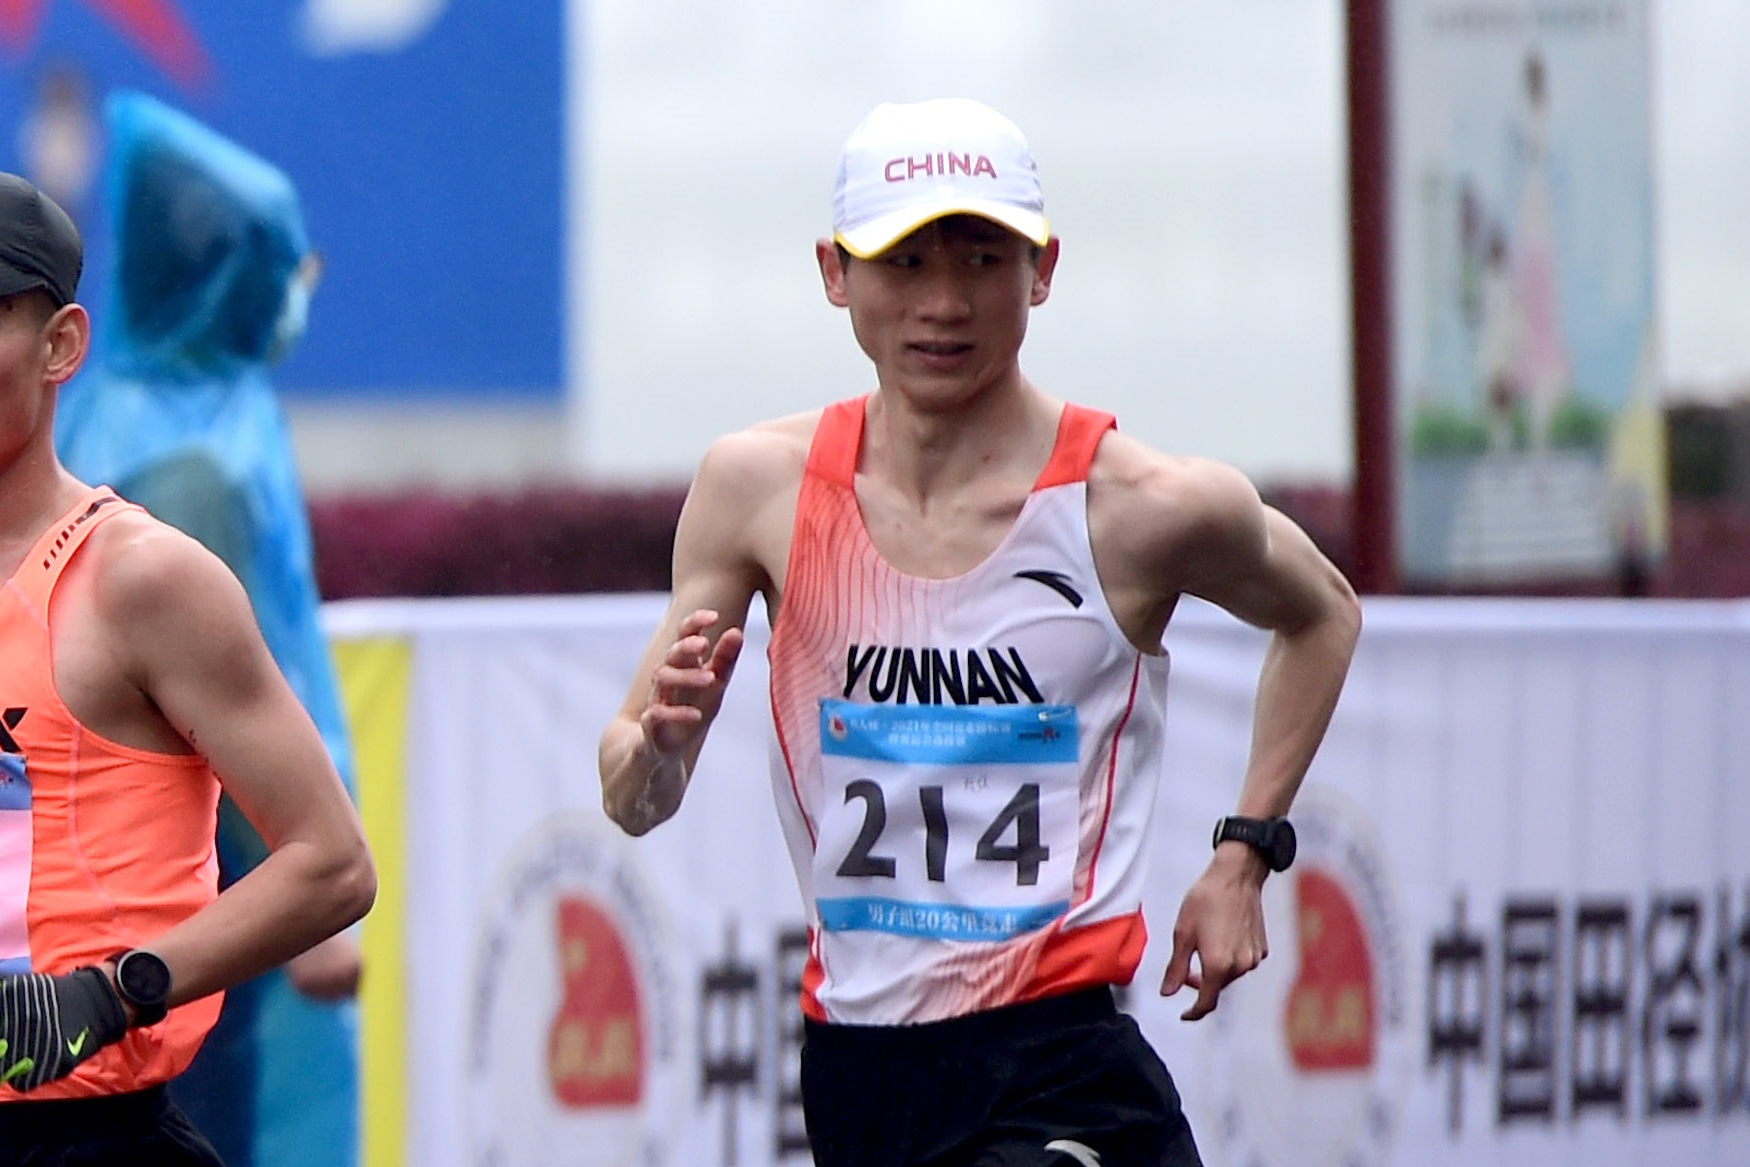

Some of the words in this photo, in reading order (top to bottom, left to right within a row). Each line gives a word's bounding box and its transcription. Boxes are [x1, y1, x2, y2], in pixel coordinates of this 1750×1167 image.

[884, 152, 997, 182] CHINA
[843, 644, 1044, 705] YUNNAN
[835, 778, 1049, 886] 214
